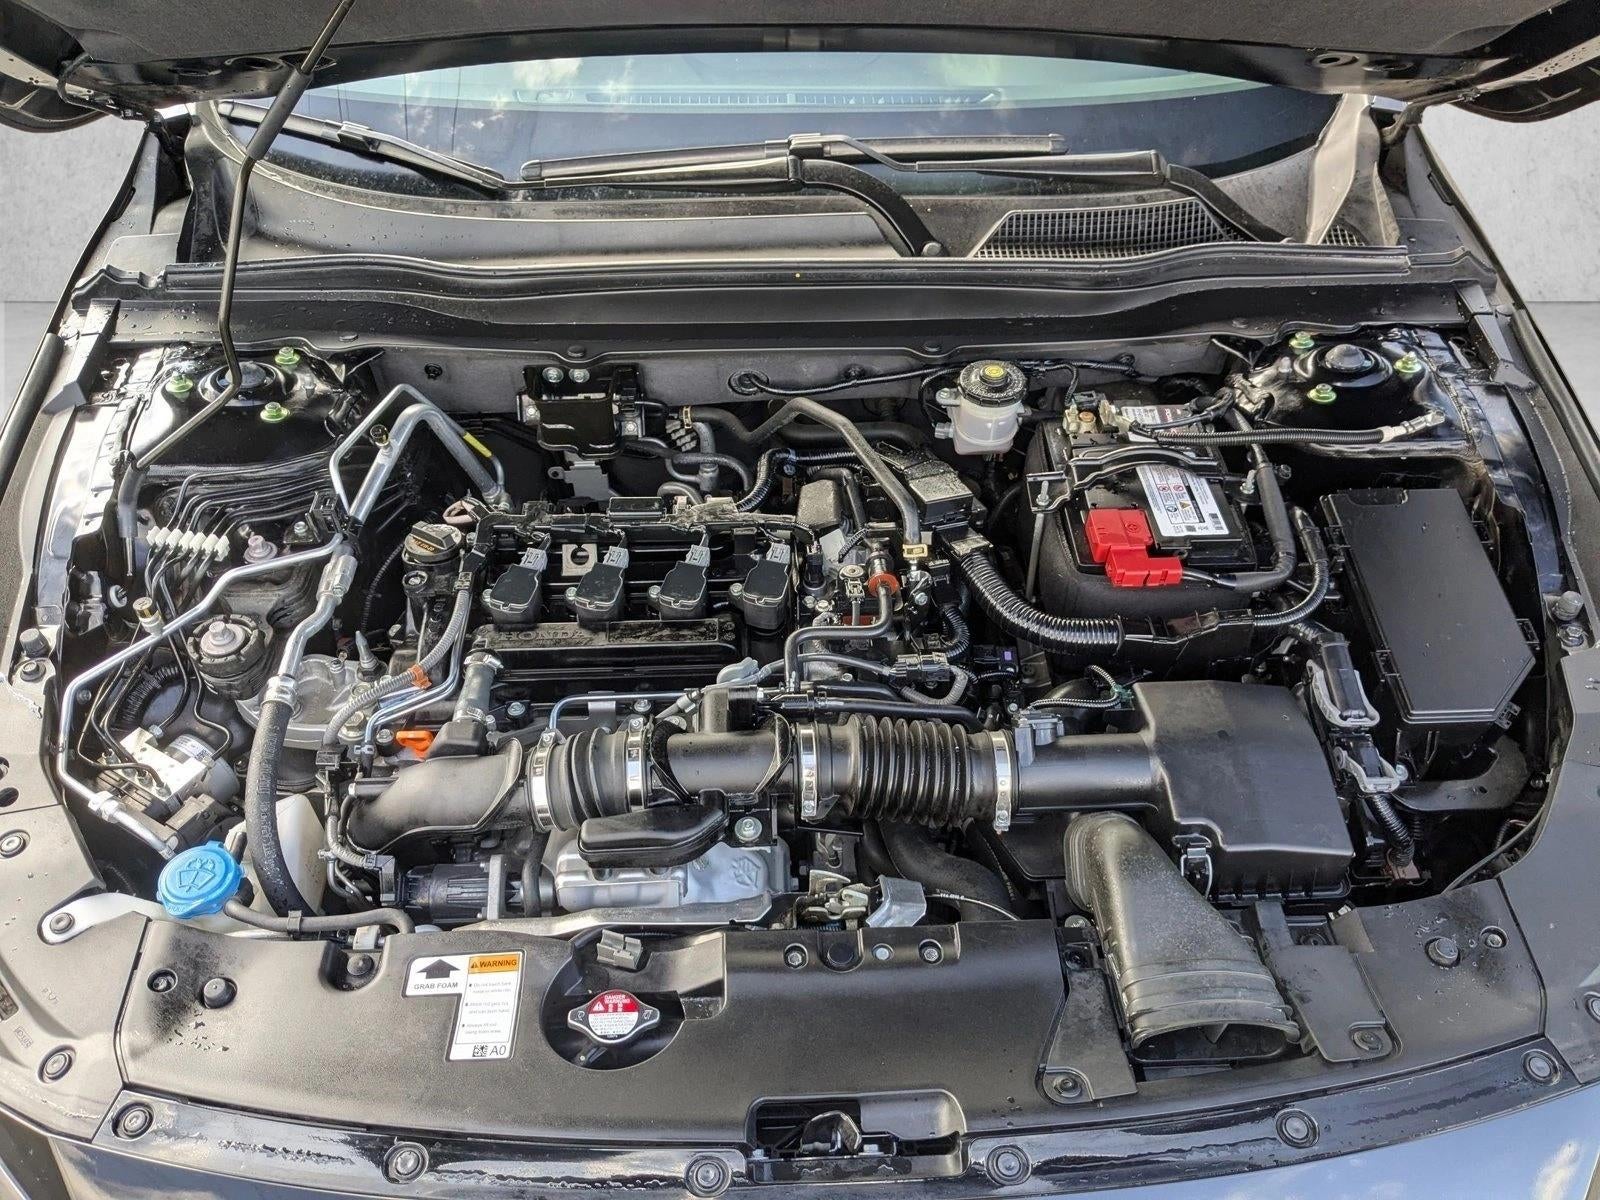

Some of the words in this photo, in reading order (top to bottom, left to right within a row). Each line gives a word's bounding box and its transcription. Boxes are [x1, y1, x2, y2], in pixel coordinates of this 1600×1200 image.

[501, 629, 586, 641] HONDA
[479, 959, 517, 968] WARNING
[414, 982, 435, 990] GRAB
[437, 981, 459, 989] FOAM
[489, 1045, 507, 1056] A0
